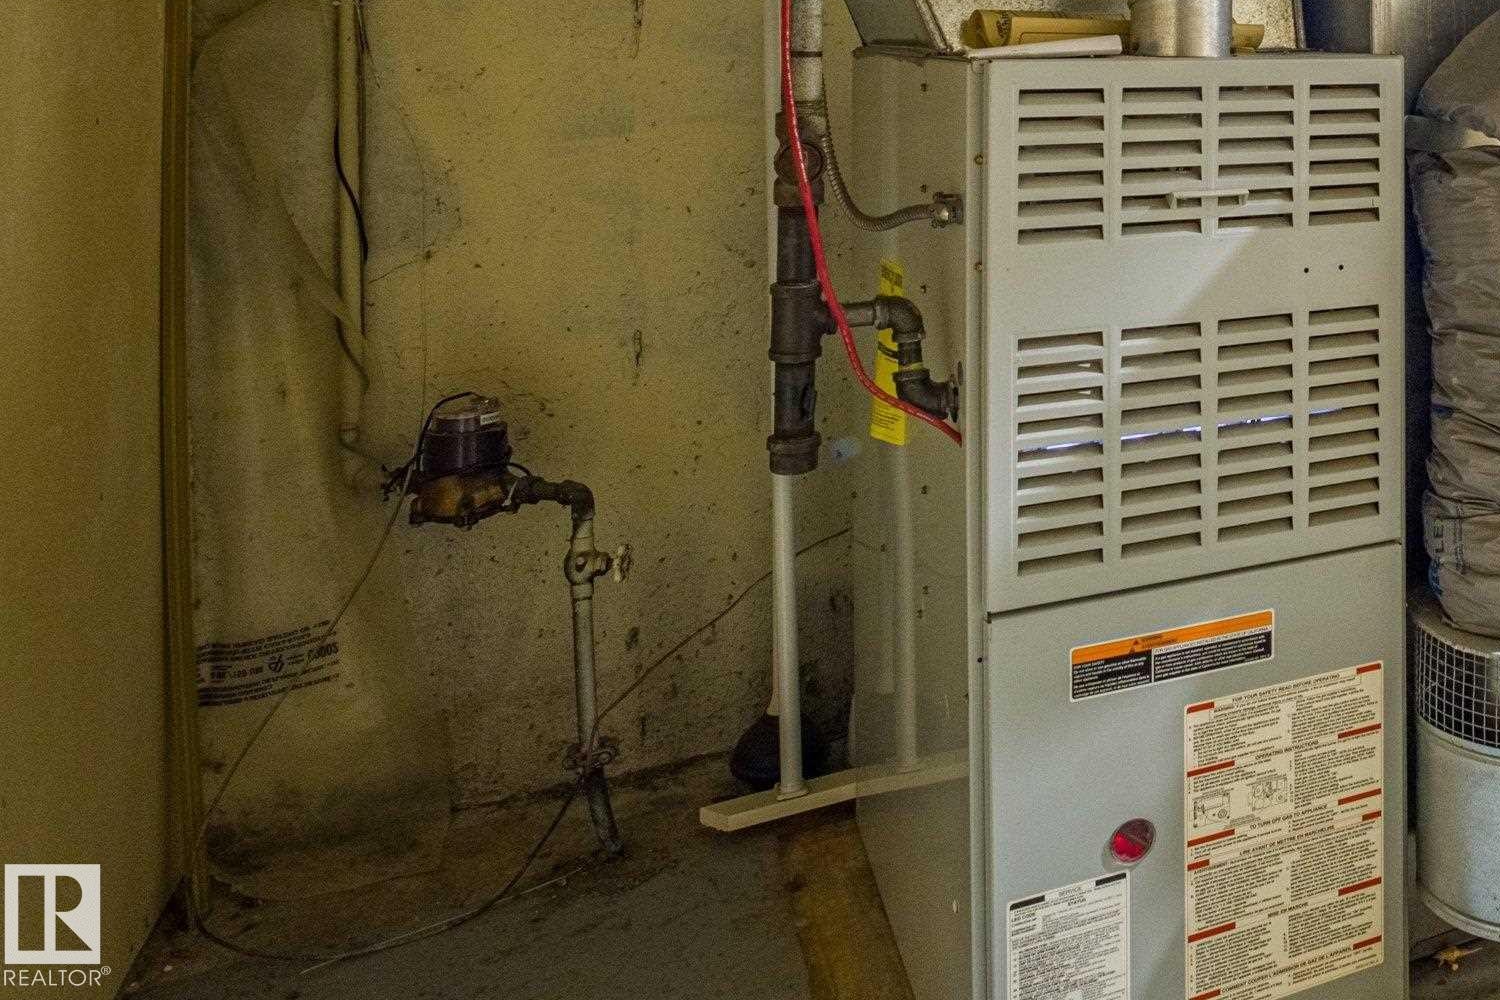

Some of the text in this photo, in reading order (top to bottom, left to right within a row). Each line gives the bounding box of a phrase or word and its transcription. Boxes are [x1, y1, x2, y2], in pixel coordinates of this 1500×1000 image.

[1259, 688, 1276, 696] SAFETY
[1292, 680, 1311, 688] BEFORE
[1313, 673, 1339, 683] OPERATING
[1255, 739, 1318, 759] OPERATING INSTRUCTIONS
[1301, 803, 1327, 815] APPLIANCE
[1276, 836, 1295, 845] METTRE
[1222, 981, 1246, 993] COMMENT
